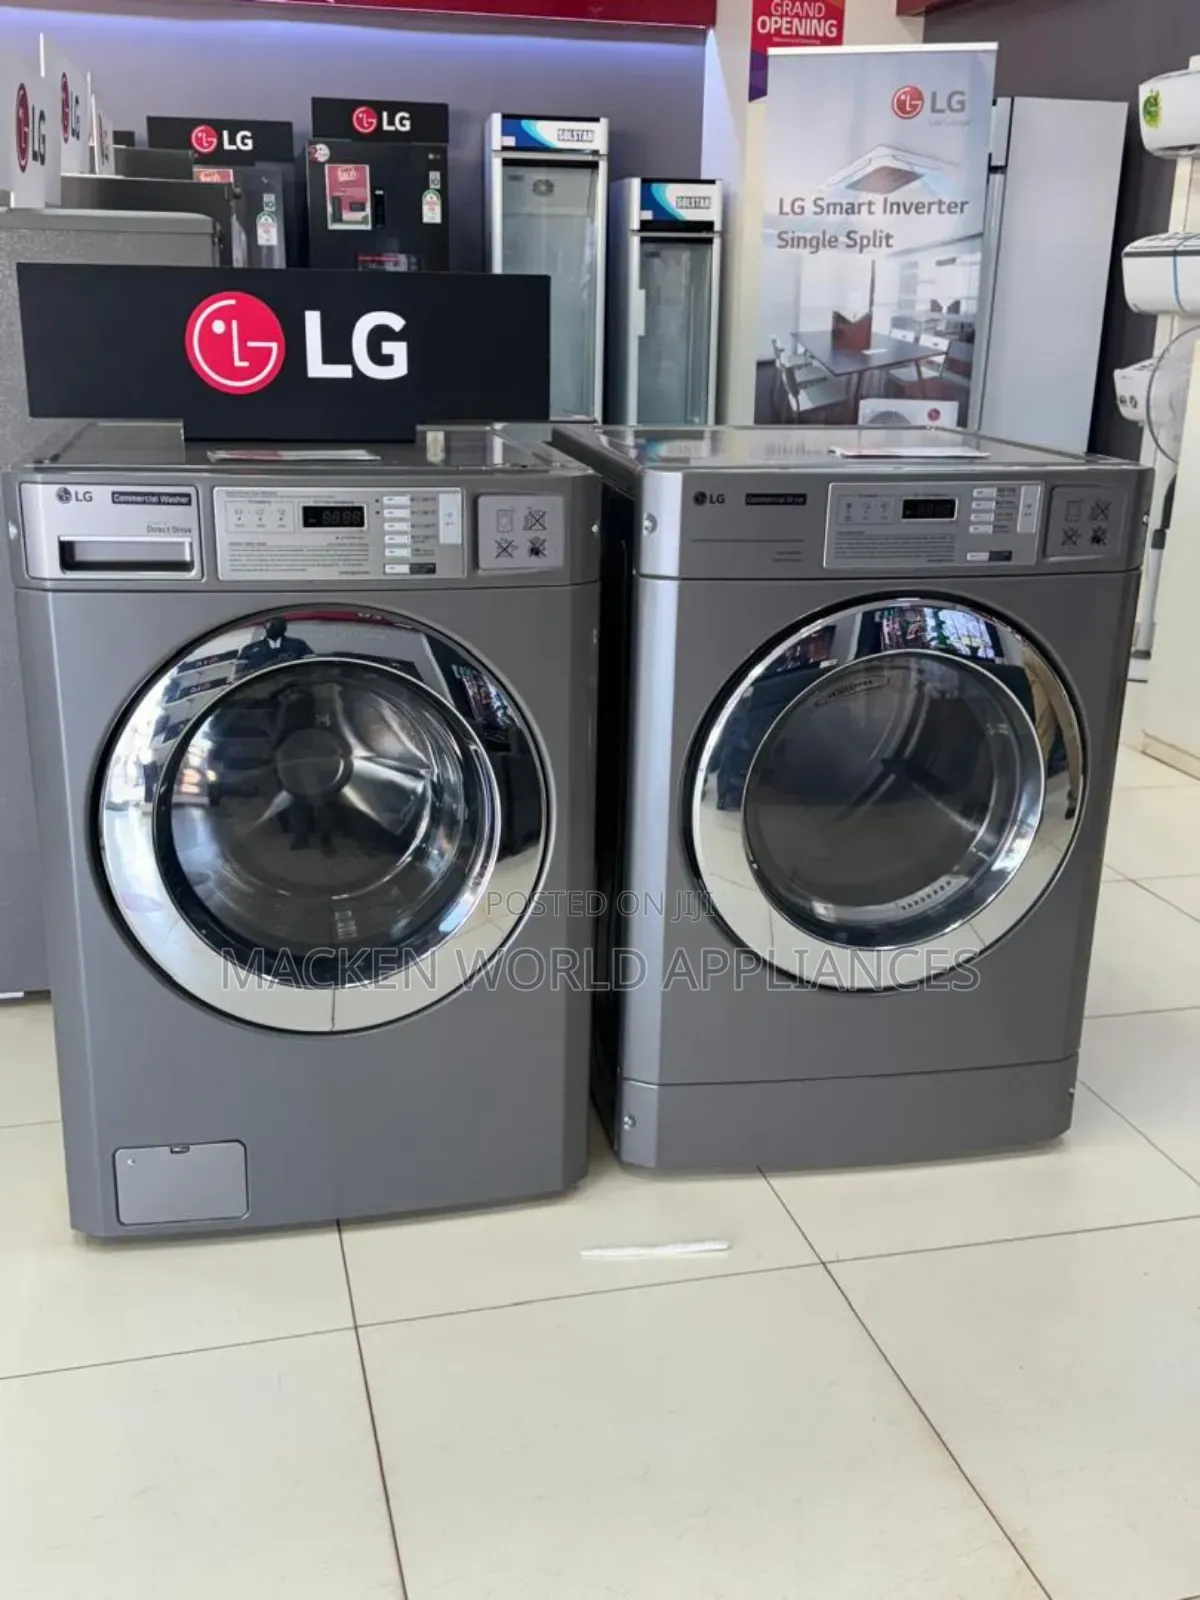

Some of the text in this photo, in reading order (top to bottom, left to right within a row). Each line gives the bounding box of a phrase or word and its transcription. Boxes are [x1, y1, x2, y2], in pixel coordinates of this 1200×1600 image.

[771, 0, 826, 18] GRAND
[757, 15, 838, 38] OPENING
[930, 90, 967, 114] LG
[382, 111, 411, 132] LG
[31, 104, 47, 166] LG
[222, 130, 254, 151] LG
[778, 196, 969, 216] LG Smart Inverter
[776, 229, 894, 255] Single Split
[304, 310, 409, 380] LG
[75, 490, 93, 502] LG
[113, 493, 159, 503] Commercial
[708, 493, 726, 504] LG
